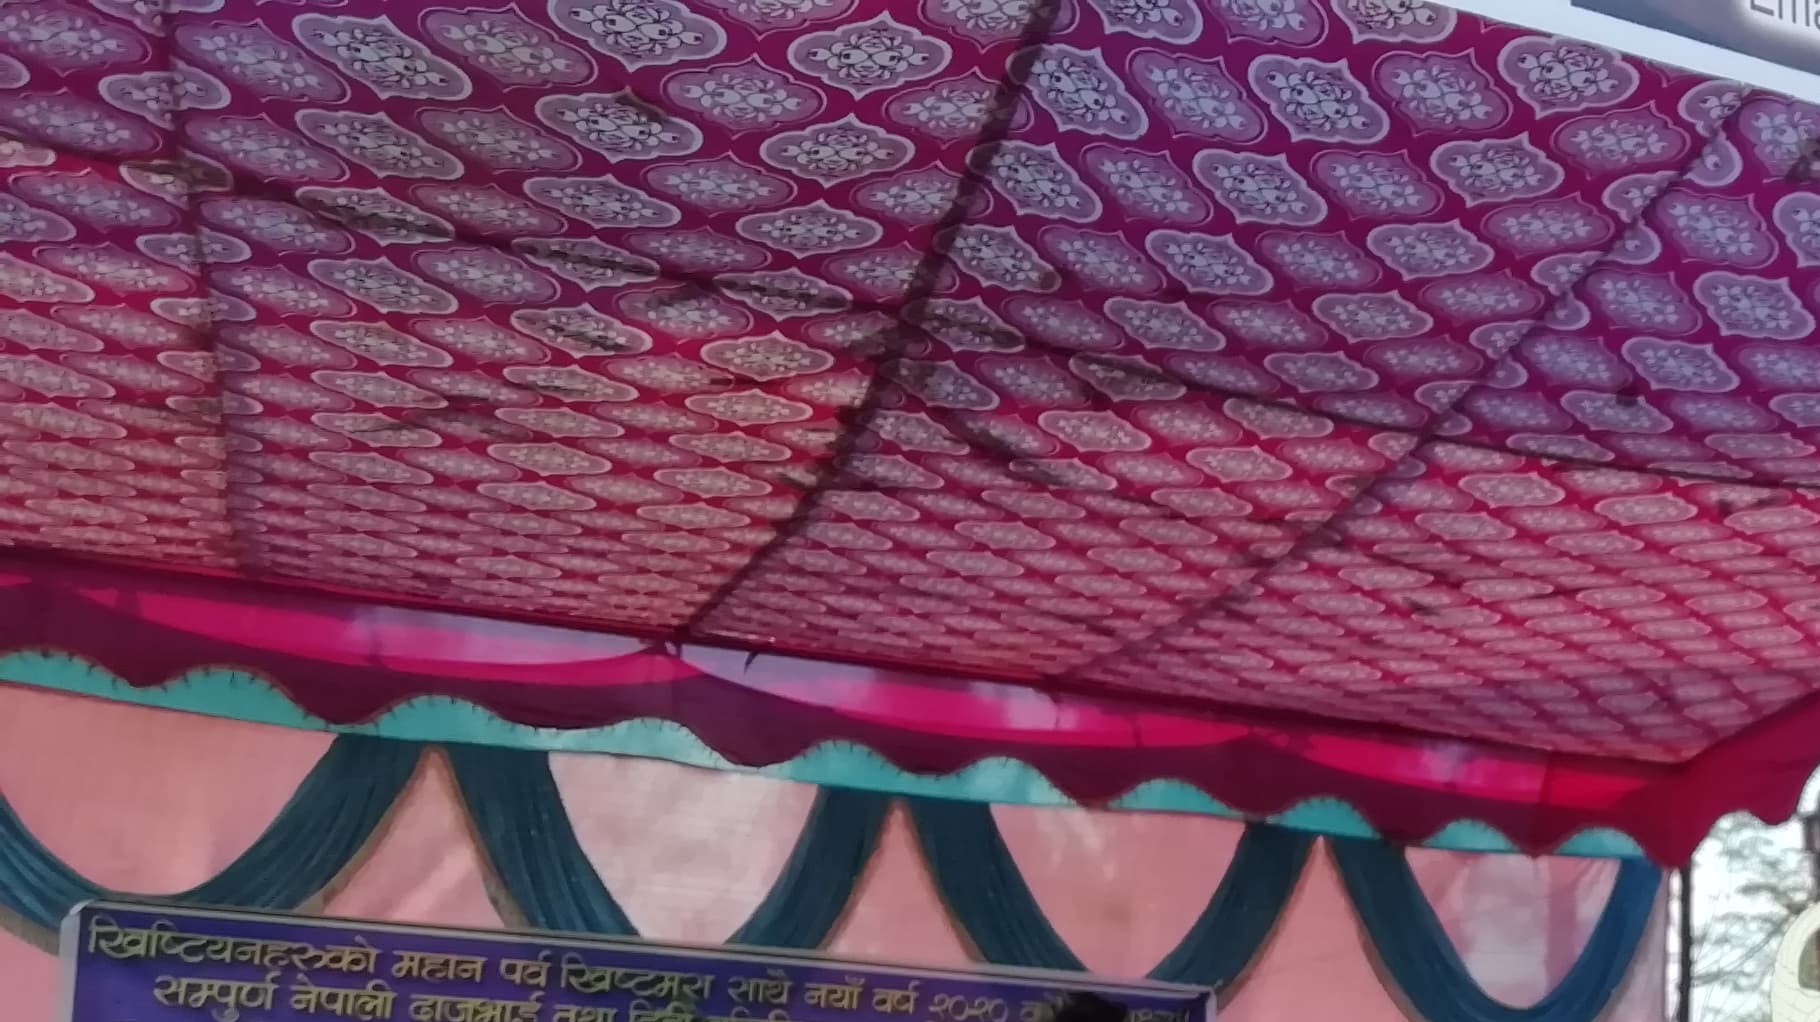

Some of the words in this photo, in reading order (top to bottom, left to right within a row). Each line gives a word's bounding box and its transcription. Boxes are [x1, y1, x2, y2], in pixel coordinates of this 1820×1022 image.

[289, 973, 398, 1020] नेपाली
[391, 950, 488, 983] महान
[499, 949, 552, 988] पर्व
[871, 979, 922, 1015] वर्ष
